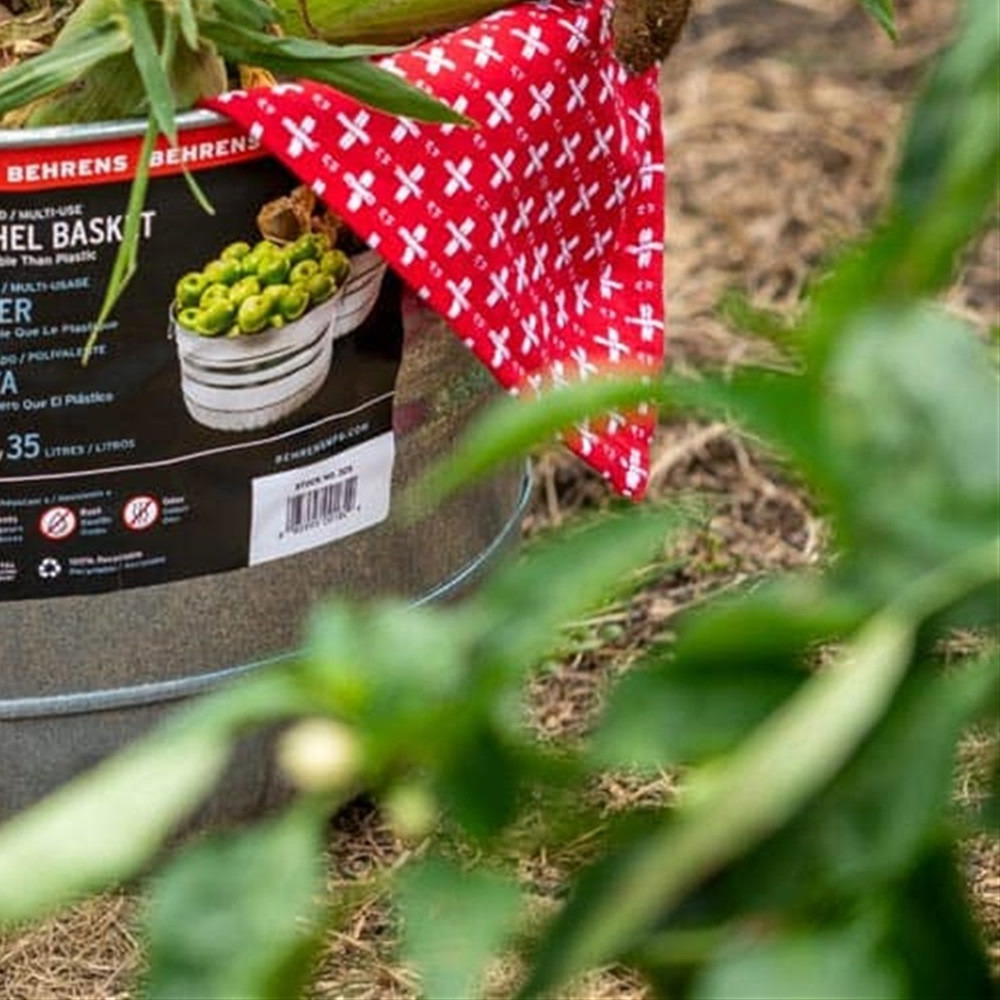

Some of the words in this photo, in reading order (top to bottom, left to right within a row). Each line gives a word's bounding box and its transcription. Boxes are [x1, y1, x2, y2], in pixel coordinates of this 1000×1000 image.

[7, 155, 128, 183] BEHRENS
[18, 204, 83, 220] MULTI-USE
[52, 210, 156, 250] BASKT
[21, 254, 53, 266] Than
[55, 250, 97, 265] Plastic
[14, 326, 40, 339] Que
[28, 344, 107, 362] POLIVALETE
[6, 433, 41, 460] 35
